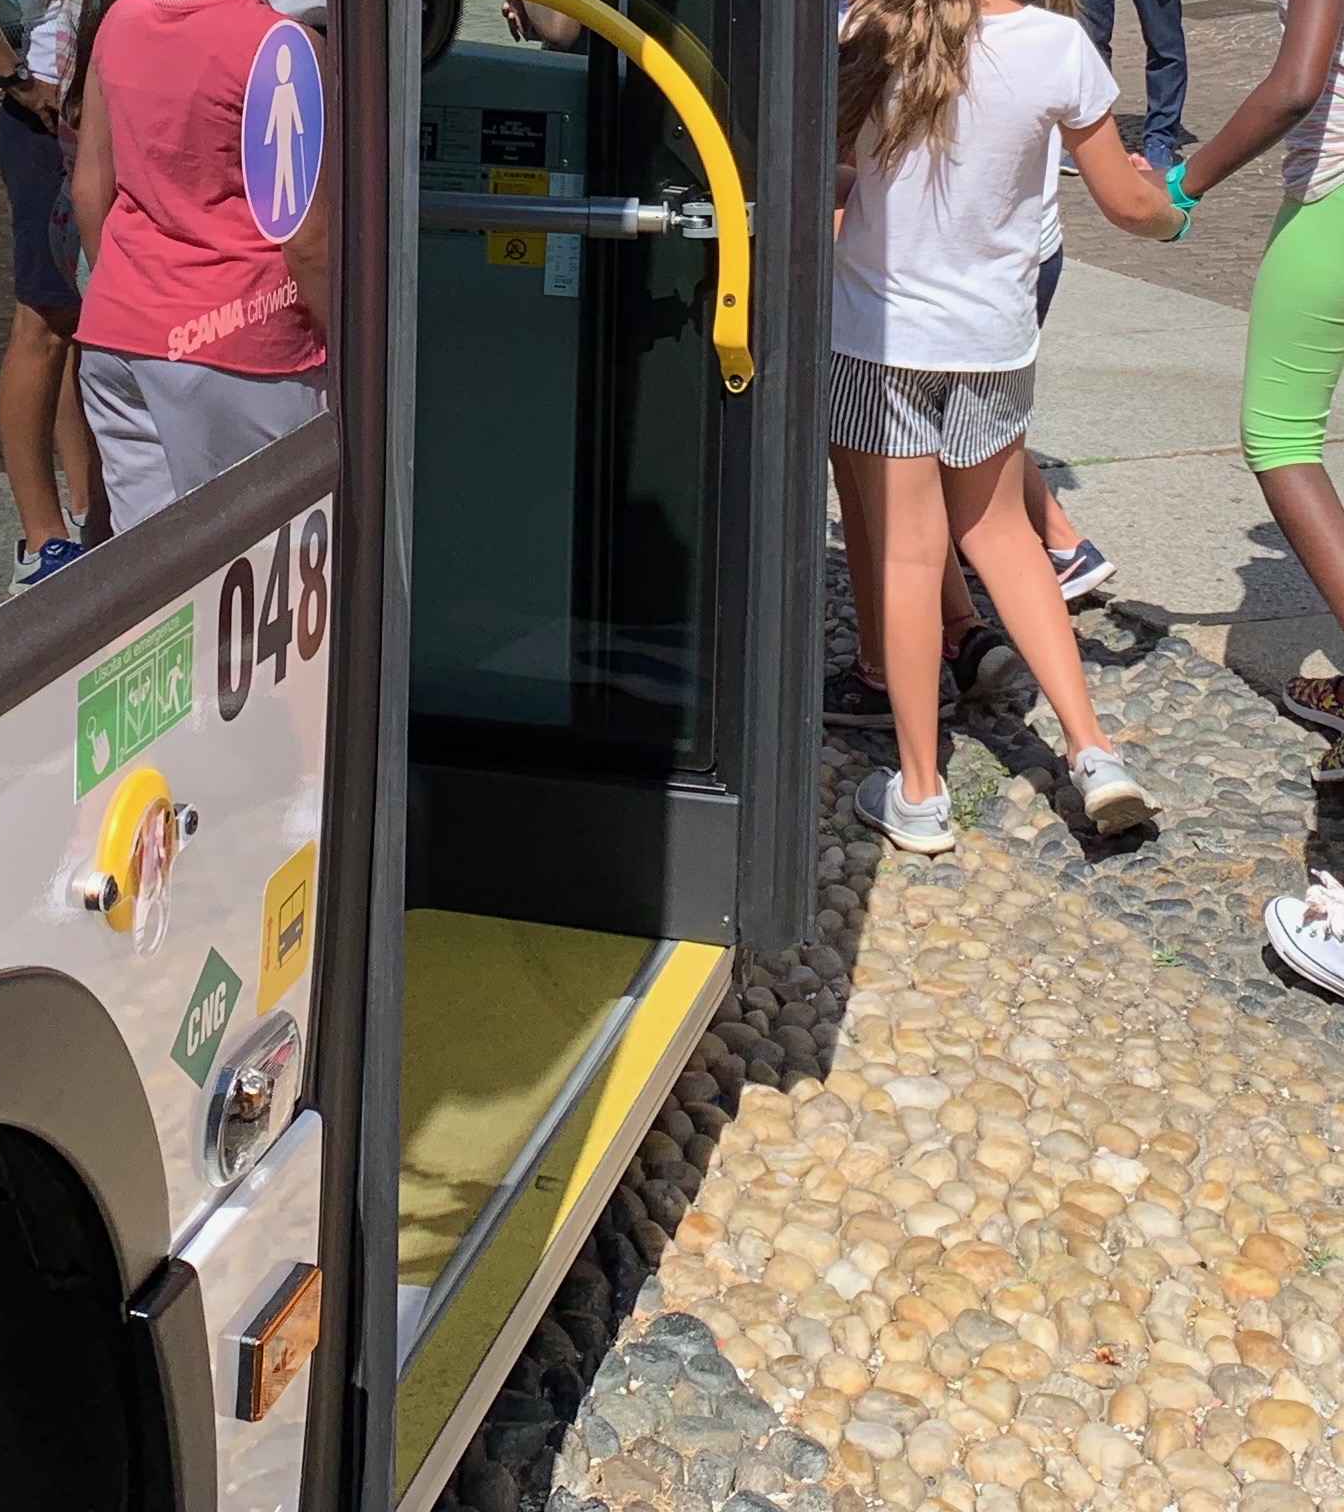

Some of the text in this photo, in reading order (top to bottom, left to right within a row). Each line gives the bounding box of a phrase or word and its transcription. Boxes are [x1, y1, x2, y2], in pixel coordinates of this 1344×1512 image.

[167, 276, 298, 362] SCANIA citywide
[94, 615, 181, 685] Uscita di emergenza
[217, 508, 328, 722] 048
[186, 981, 227, 1057] CNG
